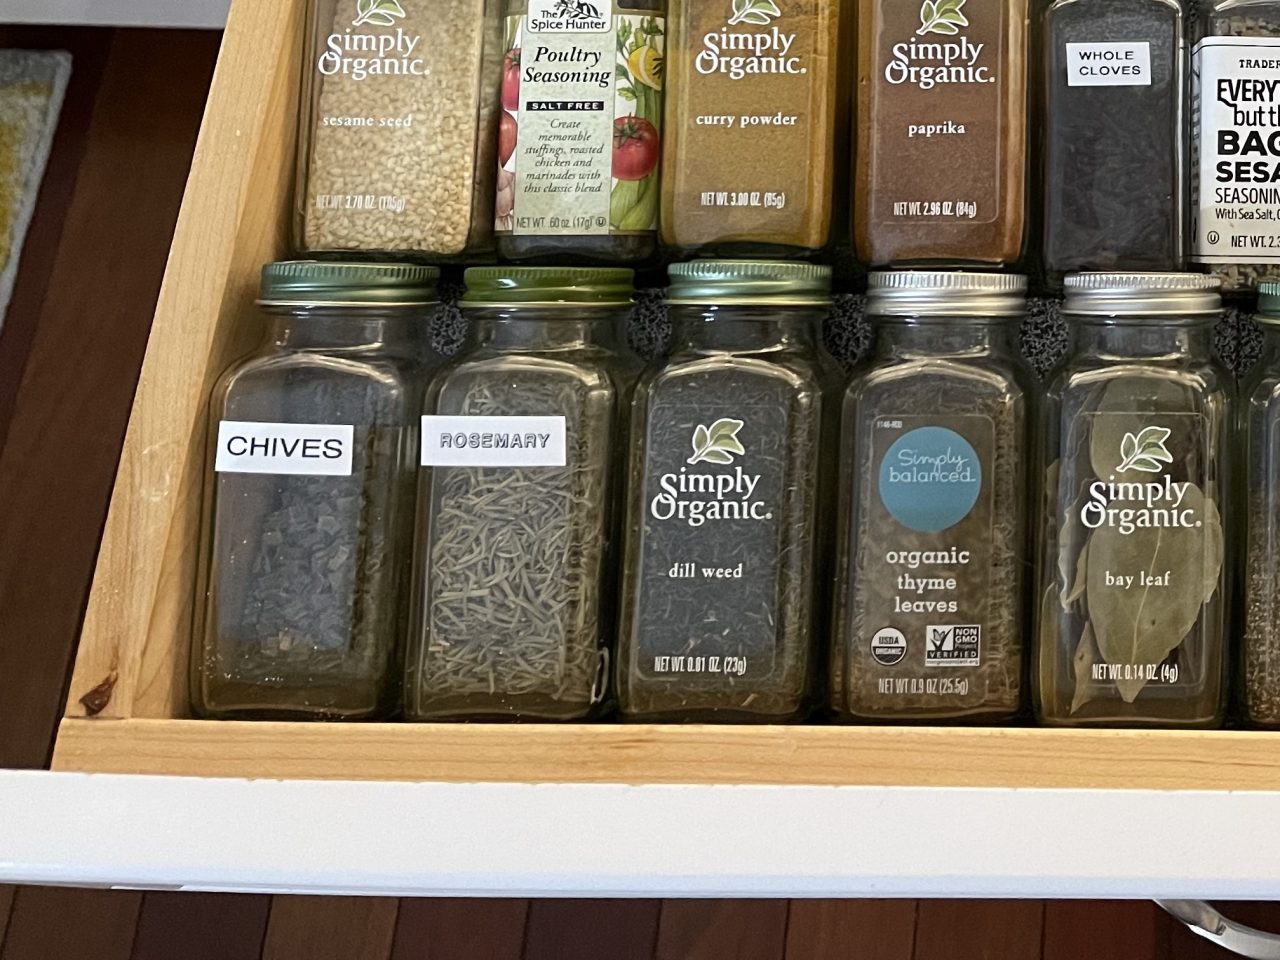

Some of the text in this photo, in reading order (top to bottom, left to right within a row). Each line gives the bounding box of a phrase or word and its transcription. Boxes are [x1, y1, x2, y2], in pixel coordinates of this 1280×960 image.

[531, 19, 606, 32] Spice Hunter
[327, 28, 420, 57] Simply
[703, 27, 795, 56] Simply
[534, 46, 602, 68] Poultry
[892, 37, 984, 66] Simply
[1079, 51, 1134, 60] WHOLE
[523, 67, 611, 88] Seasoning
[1079, 66, 1141, 75] CLOVES
[323, 114, 412, 127] sesame seed
[550, 118, 581, 129] Create
[696, 112, 797, 128] curry powder
[1234, 104, 1266, 127] but
[538, 131, 592, 141] memorable
[908, 121, 966, 137] paprika
[570, 144, 604, 154] roasted
[535, 157, 593, 167] chicken and
[526, 170, 601, 180] marinades with
[543, 184, 572, 193] classic
[1215, 208, 1237, 220] With
[227, 436, 343, 458] CHIVES
[440, 432, 551, 448] ROSEMARY
[897, 446, 968, 474] Simply
[660, 466, 761, 500] Simply
[1089, 474, 1190, 508] Simply
[886, 546, 970, 568] organic
[668, 563, 742, 578] dill weed
[897, 574, 957, 594] thyme
[1105, 571, 1171, 589] bay leaf
[894, 596, 958, 613] leaves
